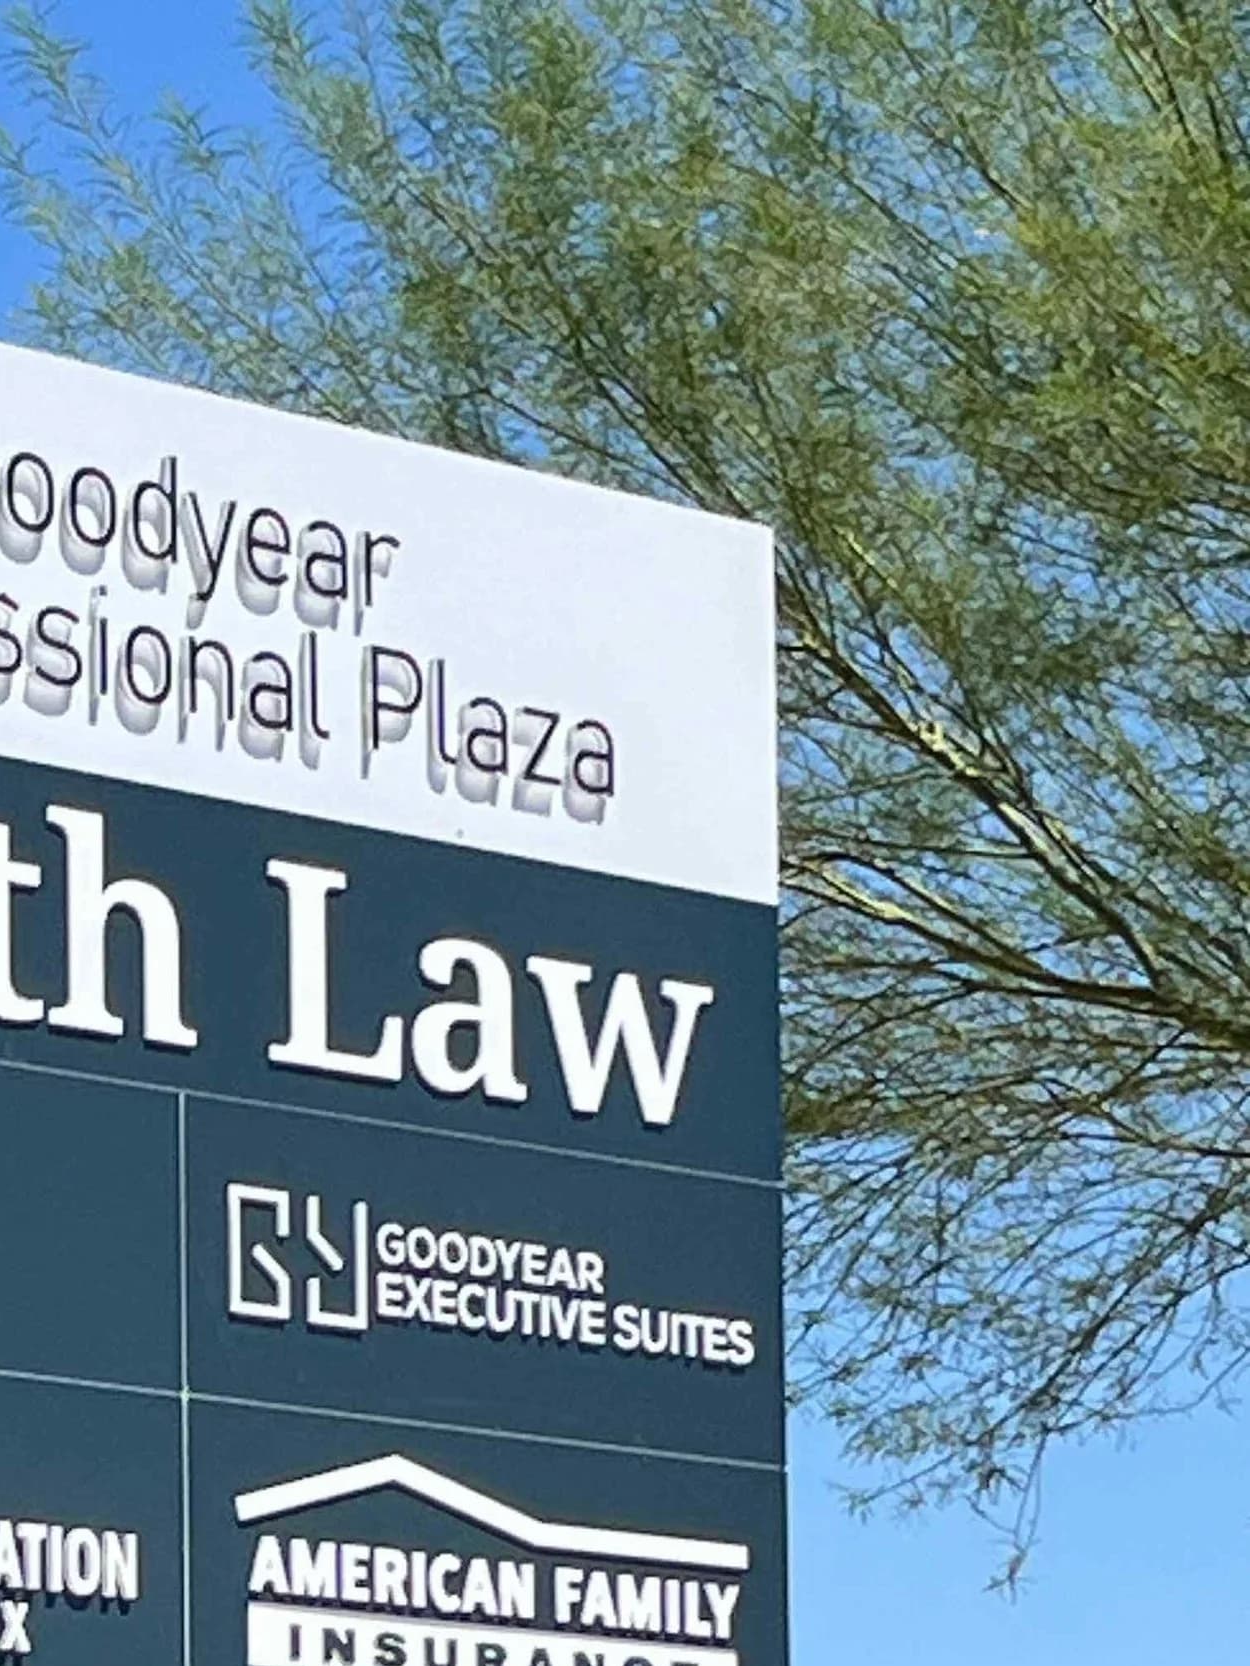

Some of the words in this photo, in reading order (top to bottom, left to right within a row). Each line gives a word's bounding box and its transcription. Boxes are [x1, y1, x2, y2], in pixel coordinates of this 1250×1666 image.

[365, 644, 616, 797] Plaza
[265, 856, 715, 1127] Law
[376, 1223, 605, 1294] GOODYEAR
[376, 1272, 607, 1347] EXECUTIVE
[612, 1304, 754, 1366] SUITES
[250, 1535, 535, 1621] AMERICAN
[553, 1565, 740, 1640] FAMILY
